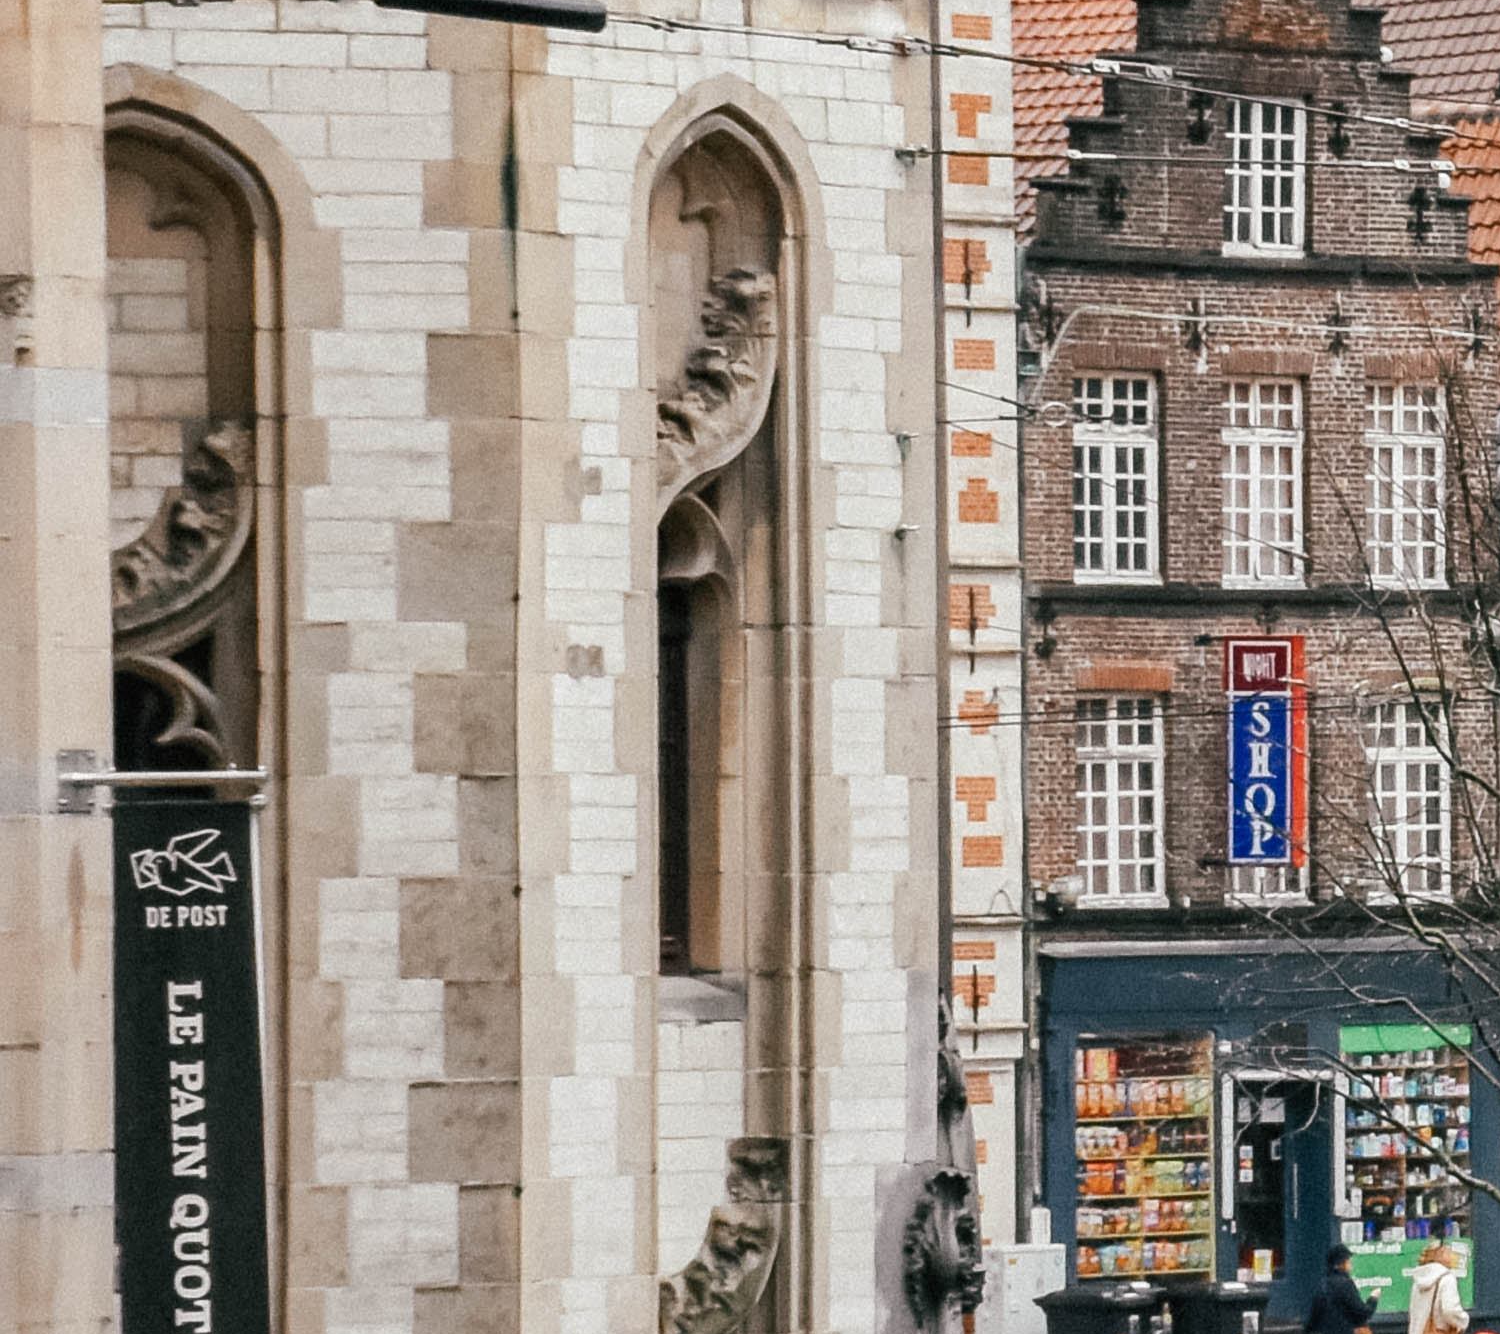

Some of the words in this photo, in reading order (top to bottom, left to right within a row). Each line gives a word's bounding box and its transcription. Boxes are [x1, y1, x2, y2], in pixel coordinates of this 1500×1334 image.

[1244, 701, 1277, 857] SHOP
[145, 906, 173, 928] DE
[177, 905, 229, 927] POST
[166, 980, 206, 1044] LE
[167, 1060, 208, 1179] PAIN
